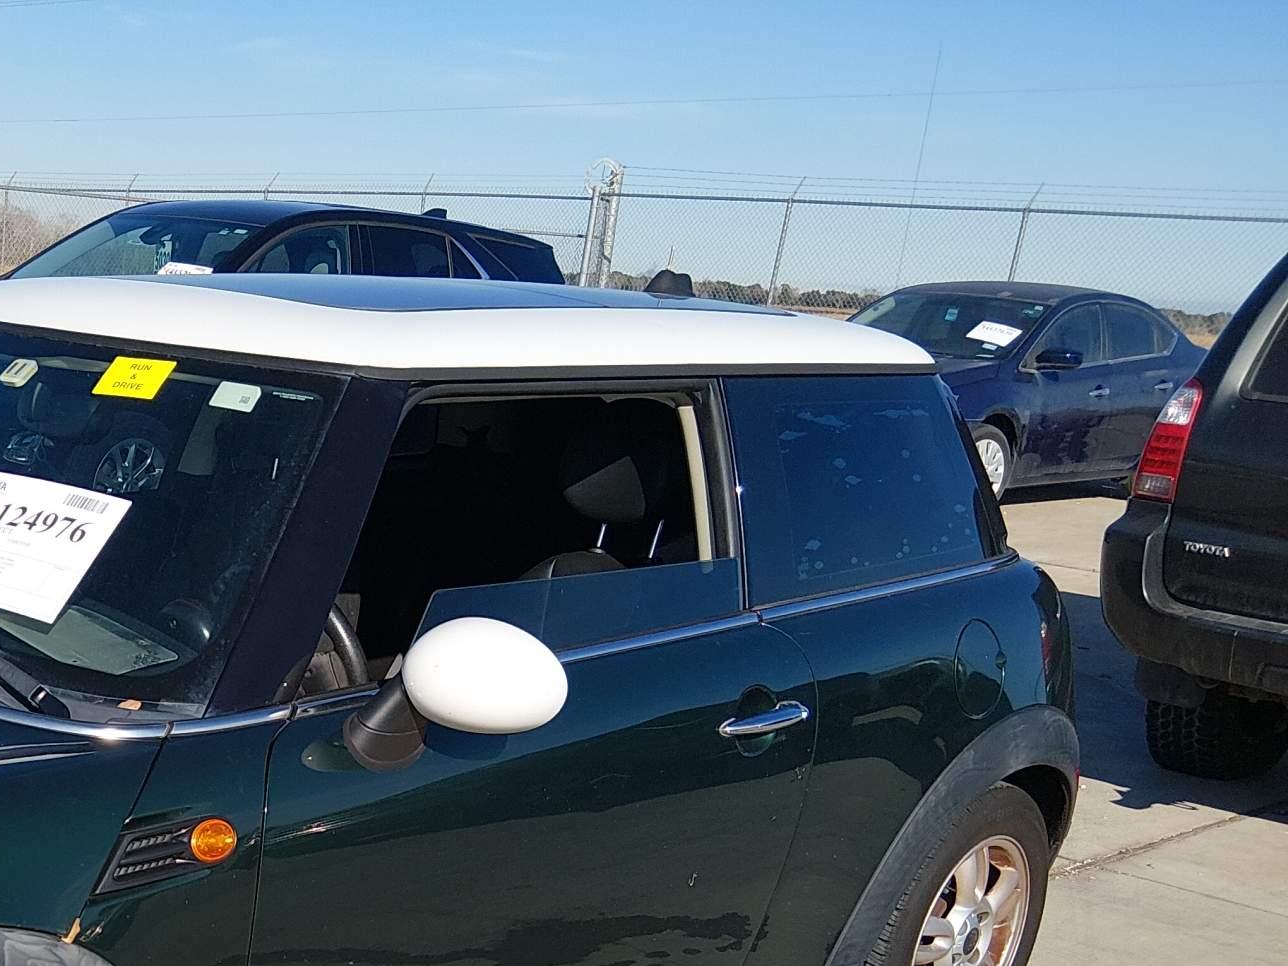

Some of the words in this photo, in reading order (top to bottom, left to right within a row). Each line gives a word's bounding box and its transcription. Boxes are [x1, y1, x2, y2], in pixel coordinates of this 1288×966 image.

[129, 363, 153, 371] RUN
[112, 381, 144, 391] DRIVE
[1183, 540, 1230, 558] TOYOTA
